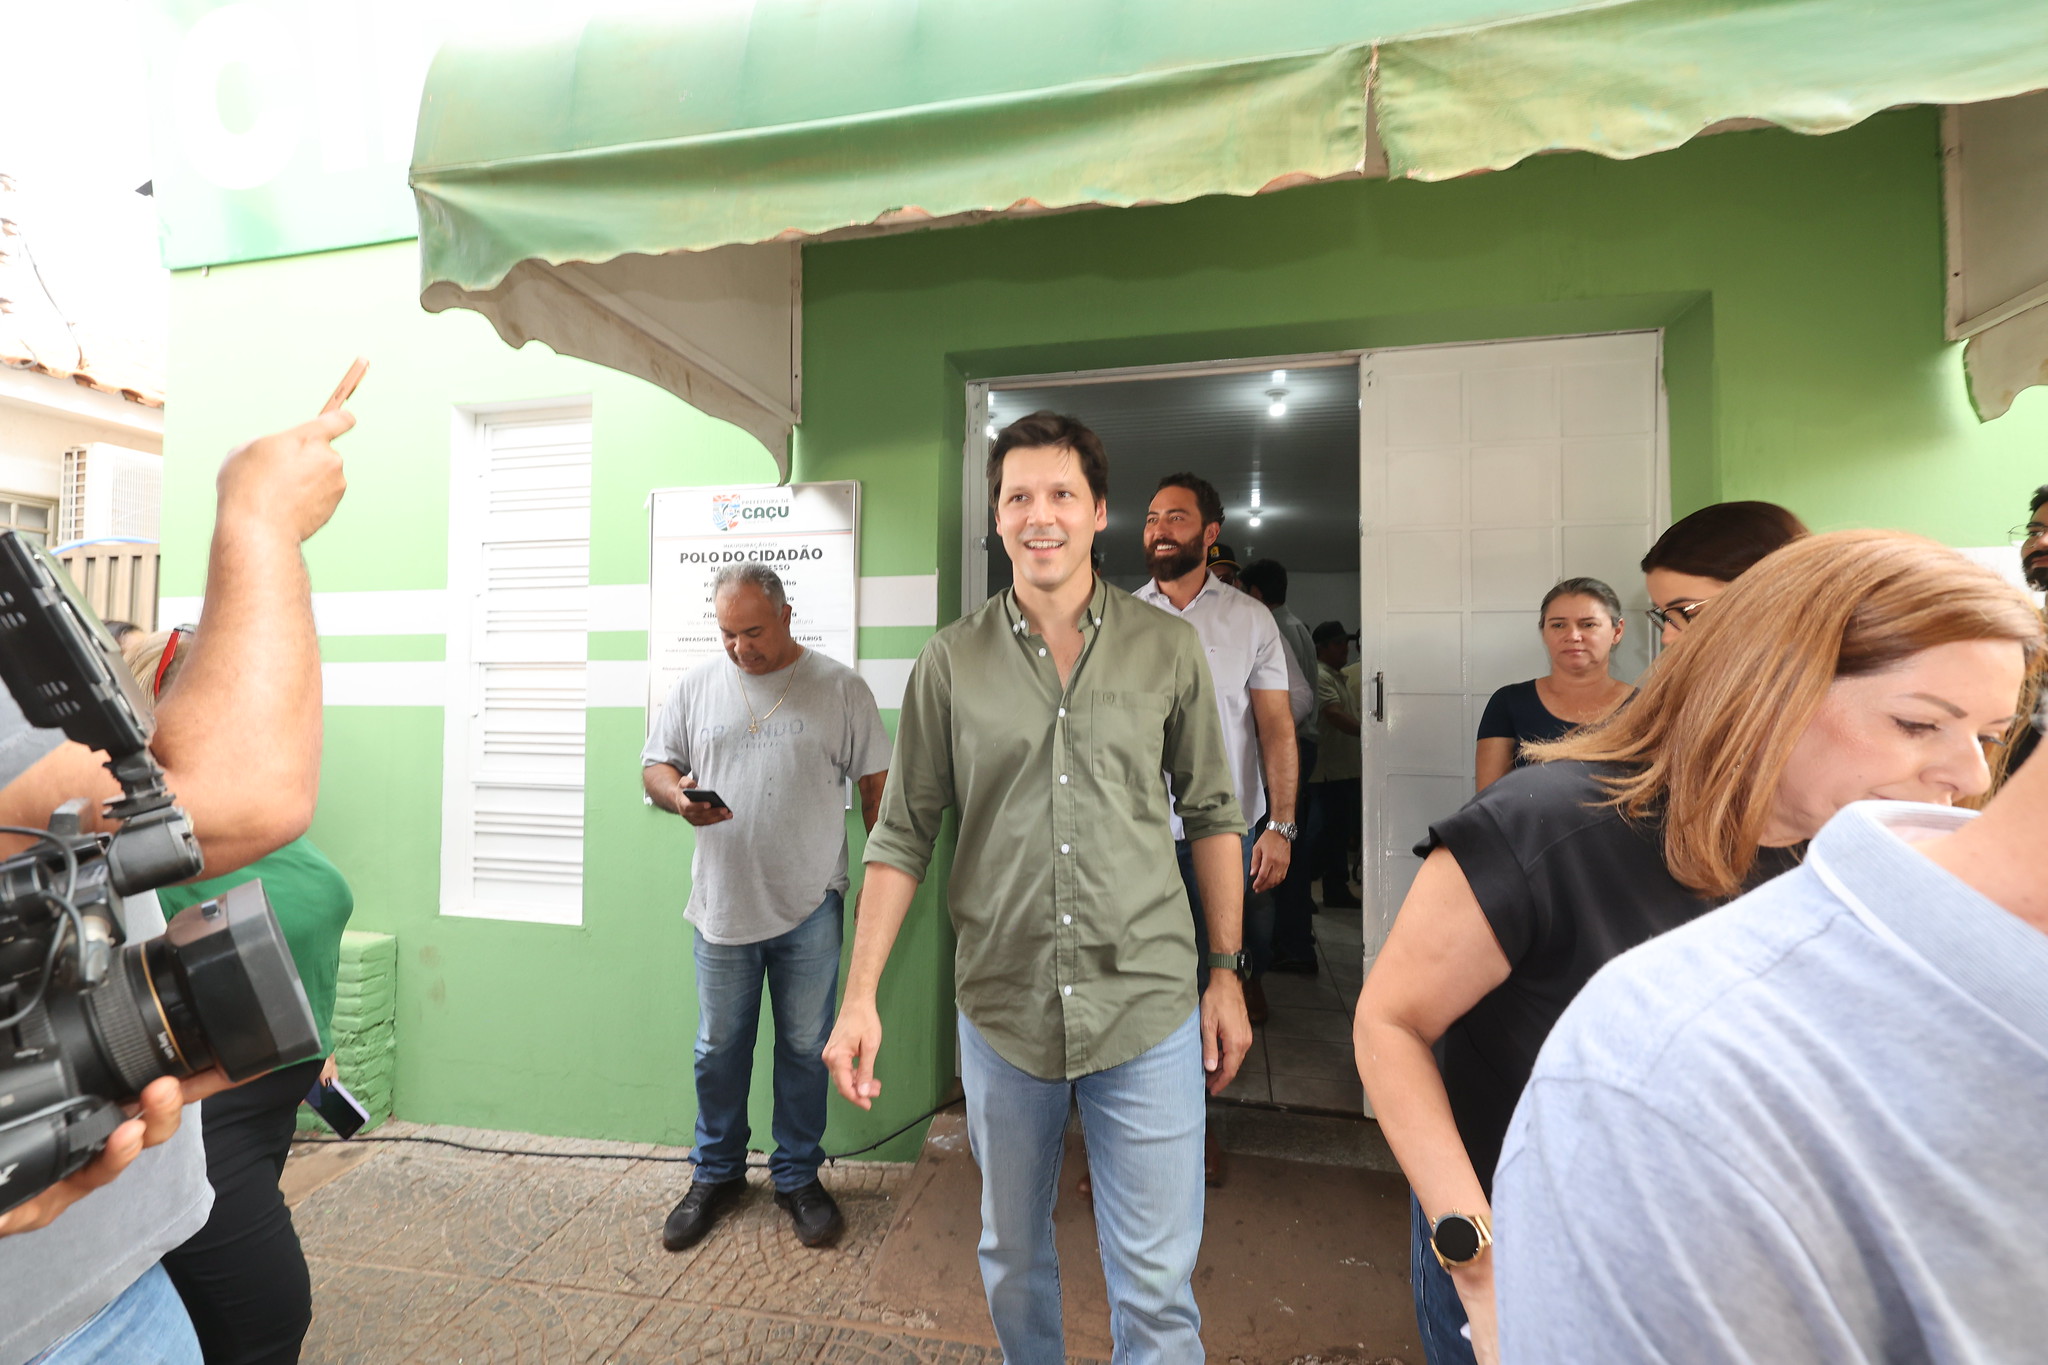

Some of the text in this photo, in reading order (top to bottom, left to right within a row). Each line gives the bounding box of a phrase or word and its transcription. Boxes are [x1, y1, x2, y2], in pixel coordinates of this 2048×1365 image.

[742, 506, 789, 521] CAÇU
[680, 544, 823, 564] POLO DO CIDADÃO
